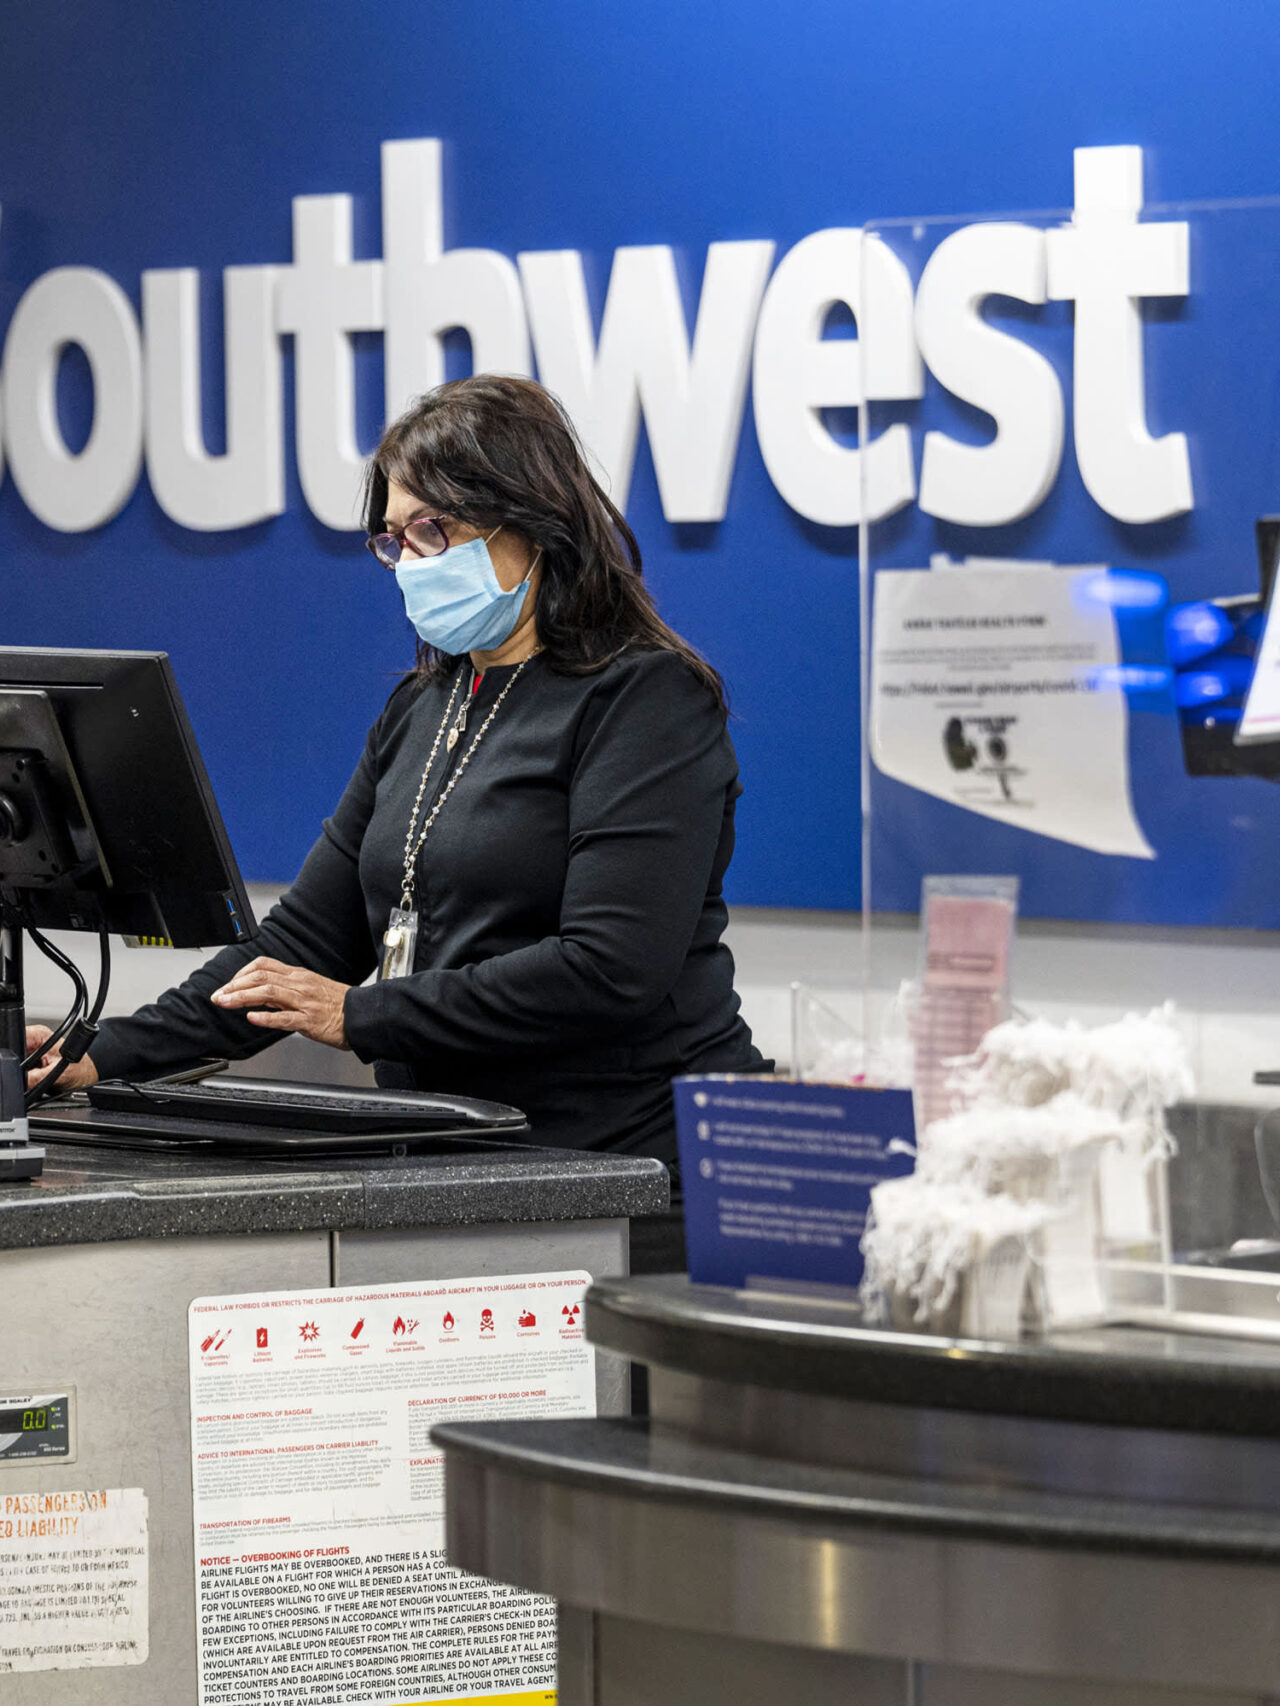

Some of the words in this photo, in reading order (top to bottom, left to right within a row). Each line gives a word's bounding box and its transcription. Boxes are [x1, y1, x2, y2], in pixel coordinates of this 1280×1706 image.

[407, 1398, 447, 1406] DECLARATION
[22, 1409, 46, 1430] 0.0
[229, 1448, 274, 1456] INTERNATIONAL
[410, 1455, 444, 1467] EXPLANATIO
[199, 1520, 251, 1528] TRANSPORTATION
[200, 1556, 230, 1565] NOTICE
[240, 1550, 301, 1562] OVERBOOKING
[303, 1549, 314, 1557] OF
[316, 1546, 349, 1556] FLIGHTS
[200, 1567, 232, 1577] AIRLINE
[234, 1564, 268, 1574] FLIGHTS
[270, 1563, 288, 1571] MAY
[290, 1561, 301, 1570] BE
[303, 1557, 363, 1568] OVERBOOKED,
[364, 1554, 383, 1563] AND
[384, 1552, 410, 1561] THERE
[412, 1551, 420, 1559] IS
[429, 1550, 447, 1559] SLIG
[200, 1580, 211, 1589] BE
[213, 1576, 259, 1587] AVAILABLE
[261, 1575, 274, 1583] ON
[284, 1572, 313, 1581] FLIGHT
[315, 1570, 332, 1578] FOR
[334, 1568, 362, 1577] WHICH
[372, 1564, 404, 1574] PERSON
[406, 1562, 423, 1571] HAS
[433, 1561, 450, 1570] CO
[201, 1590, 230, 1600] FLIGHT
[232, 1589, 239, 1597] IS
[241, 1585, 301, 1596] OVERBOOKED,
[303, 1583, 316, 1591] NO
[318, 1581, 335, 1590] ONE
[337, 1580, 358, 1588] WILL
[359, 1578, 370, 1586] BE
[372, 1576, 402, 1585] DENIED
[412, 1573, 432, 1582] SEAT
[434, 1571, 458, 1580] UNTIL
[201, 1603, 218, 1611] FOR
[220, 1598, 275, 1609] VOLUNTEERS
[276, 1595, 311, 1605] WILLING
[313, 1593, 325, 1601] TO
[326, 1592, 346, 1601] GIVE
[348, 1591, 359, 1599] UP
[360, 1588, 384, 1597] THEIR
[386, 1583, 447, 1595] RESERVATIONS
[448, 1582, 457, 1590] IN
[460, 1579, 503, 1591] EXCHANG
[201, 1615, 213, 1623] OF
[215, 1613, 231, 1621] THE
[233, 1610, 273, 1619] AIRLINE'S
[274, 1606, 320, 1617] CHOOSING.
[324, 1604, 332, 1612] IF
[334, 1602, 360, 1611] THERE
[361, 1600, 378, 1608] ARE
[380, 1598, 397, 1607] NOT
[399, 1596, 433, 1606] ENOUGH
[435, 1591, 490, 1602] VOLUNTEERS,
[492, 1589, 507, 1597] THE
